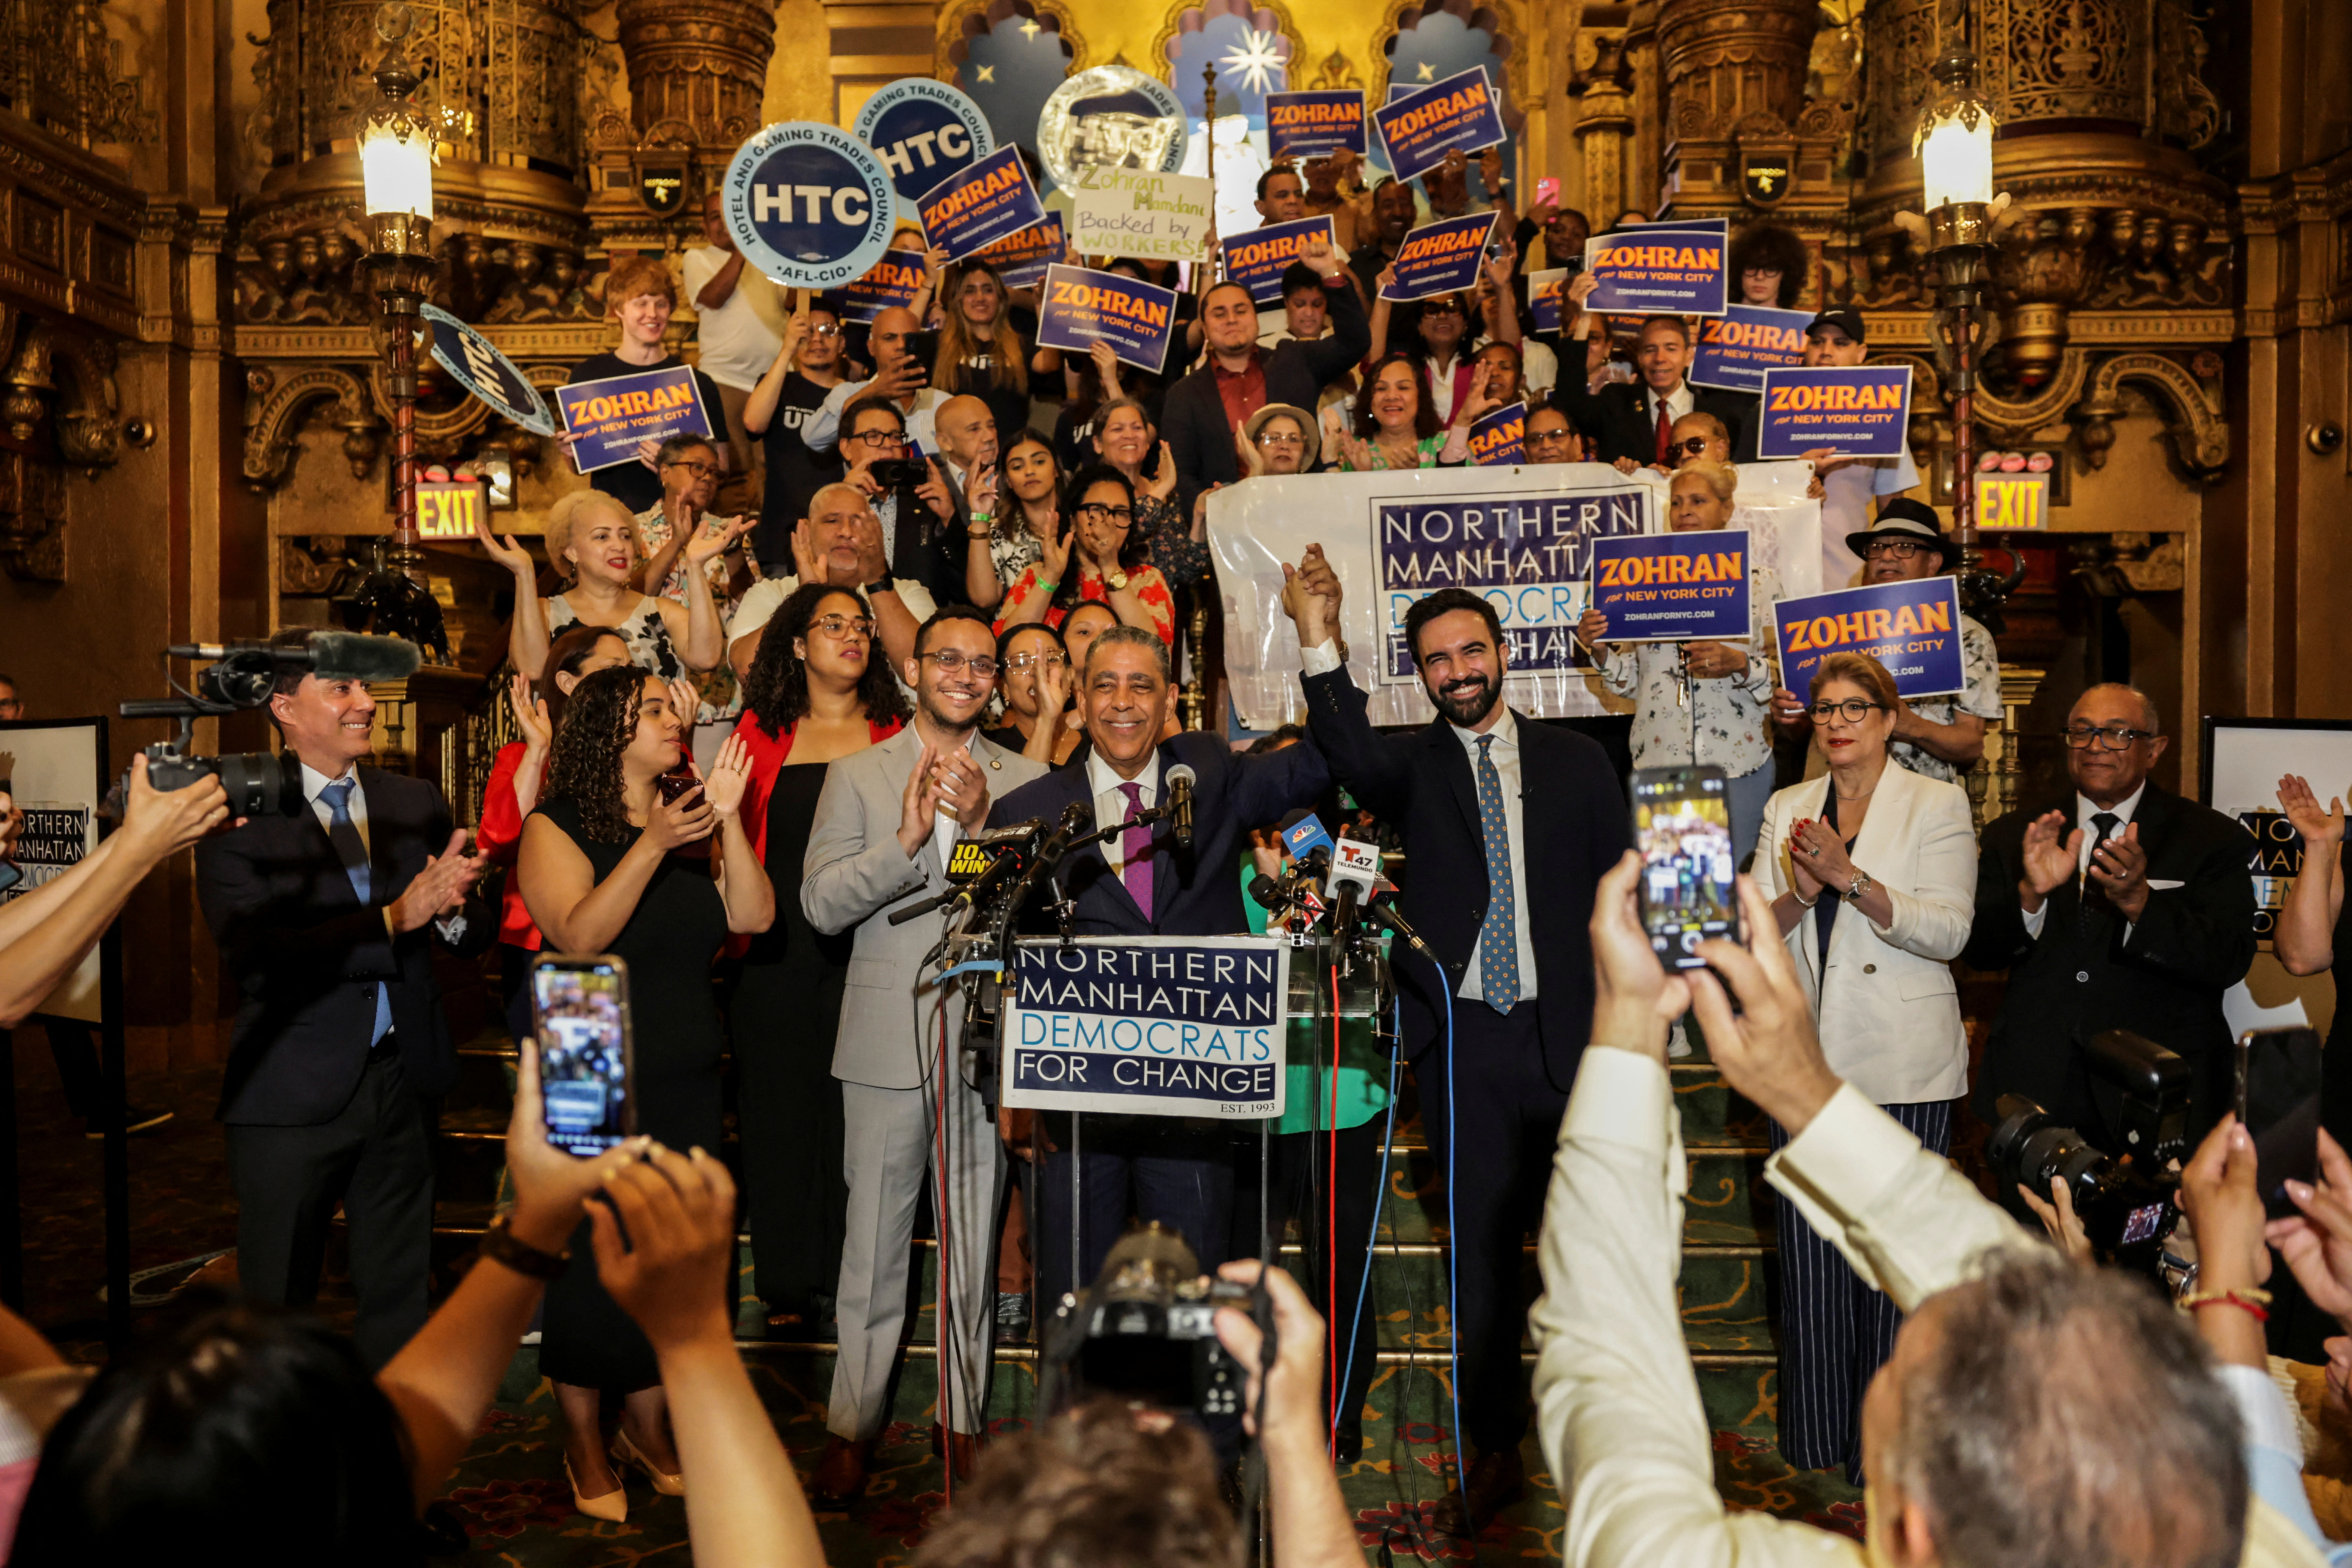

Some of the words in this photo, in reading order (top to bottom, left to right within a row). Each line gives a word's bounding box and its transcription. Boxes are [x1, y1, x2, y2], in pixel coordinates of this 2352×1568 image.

[1140, 80, 1175, 116] RADES
[1270, 103, 1362, 125] ZOHRAN
[1384, 83, 1488, 143] ZOHRAN
[863, 88, 905, 126] GAMING
[909, 85, 961, 108] TRADES
[962, 108, 987, 159] COUNCI
[753, 129, 814, 157] GAMING
[820, 131, 875, 174] TRADES
[875, 123, 971, 179] HTC
[734, 158, 753, 190] AND
[1079, 164, 1164, 192] Zohran
[754, 184, 869, 226] HTC
[869, 177, 888, 243] COUNCIL
[924, 161, 1023, 231] ZOHRAN
[1133, 192, 1205, 216] Mamdani
[732, 194, 755, 245] HOTEL
[1077, 211, 1154, 233] Backed
[1169, 218, 1189, 239] by
[1082, 232, 1205, 258] WORKERS!
[1399, 226, 1488, 261] ZOHRAN
[1593, 246, 1720, 270] ZOHRAN
[863, 262, 926, 288] HRAN
[1618, 270, 1647, 279] NEW
[1650, 271, 1683, 281] YORK
[1685, 273, 1714, 283] CITY
[1051, 281, 1168, 328] ZOHRAN
[1073, 310, 1100, 321] NEW
[1102, 315, 1132, 330] YORK
[1134, 324, 1158, 338] CITY
[458, 331, 509, 405] HTC
[1723, 348, 1751, 359] NEW
[1753, 352, 1783, 364] YORK
[1784, 356, 1804, 365] CIT
[568, 382, 695, 427] ZOHRAN
[1769, 385, 1903, 411] ZOHRAN
[600, 421, 628, 434] NEW
[630, 414, 662, 428] YORK
[664, 407, 691, 421] CITY
[1793, 414, 1824, 424] NEW
[1826, 414, 1860, 423] YORK
[1862, 414, 1894, 423] CITY
[604, 427, 680, 450] ZOHRANFORNYC.COM
[417, 490, 477, 536] EXIT
[1977, 481, 2043, 528] EXIT
[1386, 501, 1637, 544] NORTHERN
[1388, 544, 1592, 583] MANHATT
[1599, 552, 1743, 587] ZOHRAN
[1605, 593, 1622, 604] FOR
[1626, 591, 1658, 601] NEW
[1661, 588, 1699, 599] YORK
[1702, 587, 1735, 598] CITY
[1624, 610, 1715, 621] ZOHRANFORNYC.COM
[1785, 601, 1952, 653] ZOHRAN
[1797, 657, 1816, 670] FOR
[1907, 639, 1944, 653] CITY
[1338, 861, 1373, 873] TELEMUNDO
[1355, 857, 1373, 866] 47
[1019, 948, 1272, 984] NORTHERN
[1020, 976, 1270, 1020] MANHATTAN
[1022, 1013, 1269, 1061] DEMOCRATS
[1020, 1053, 1088, 1083] FOR
[1113, 1058, 1271, 1093] CHANGE
[1220, 1103, 1246, 1114] EST.
[1250, 1103, 1275, 1112] 1993
